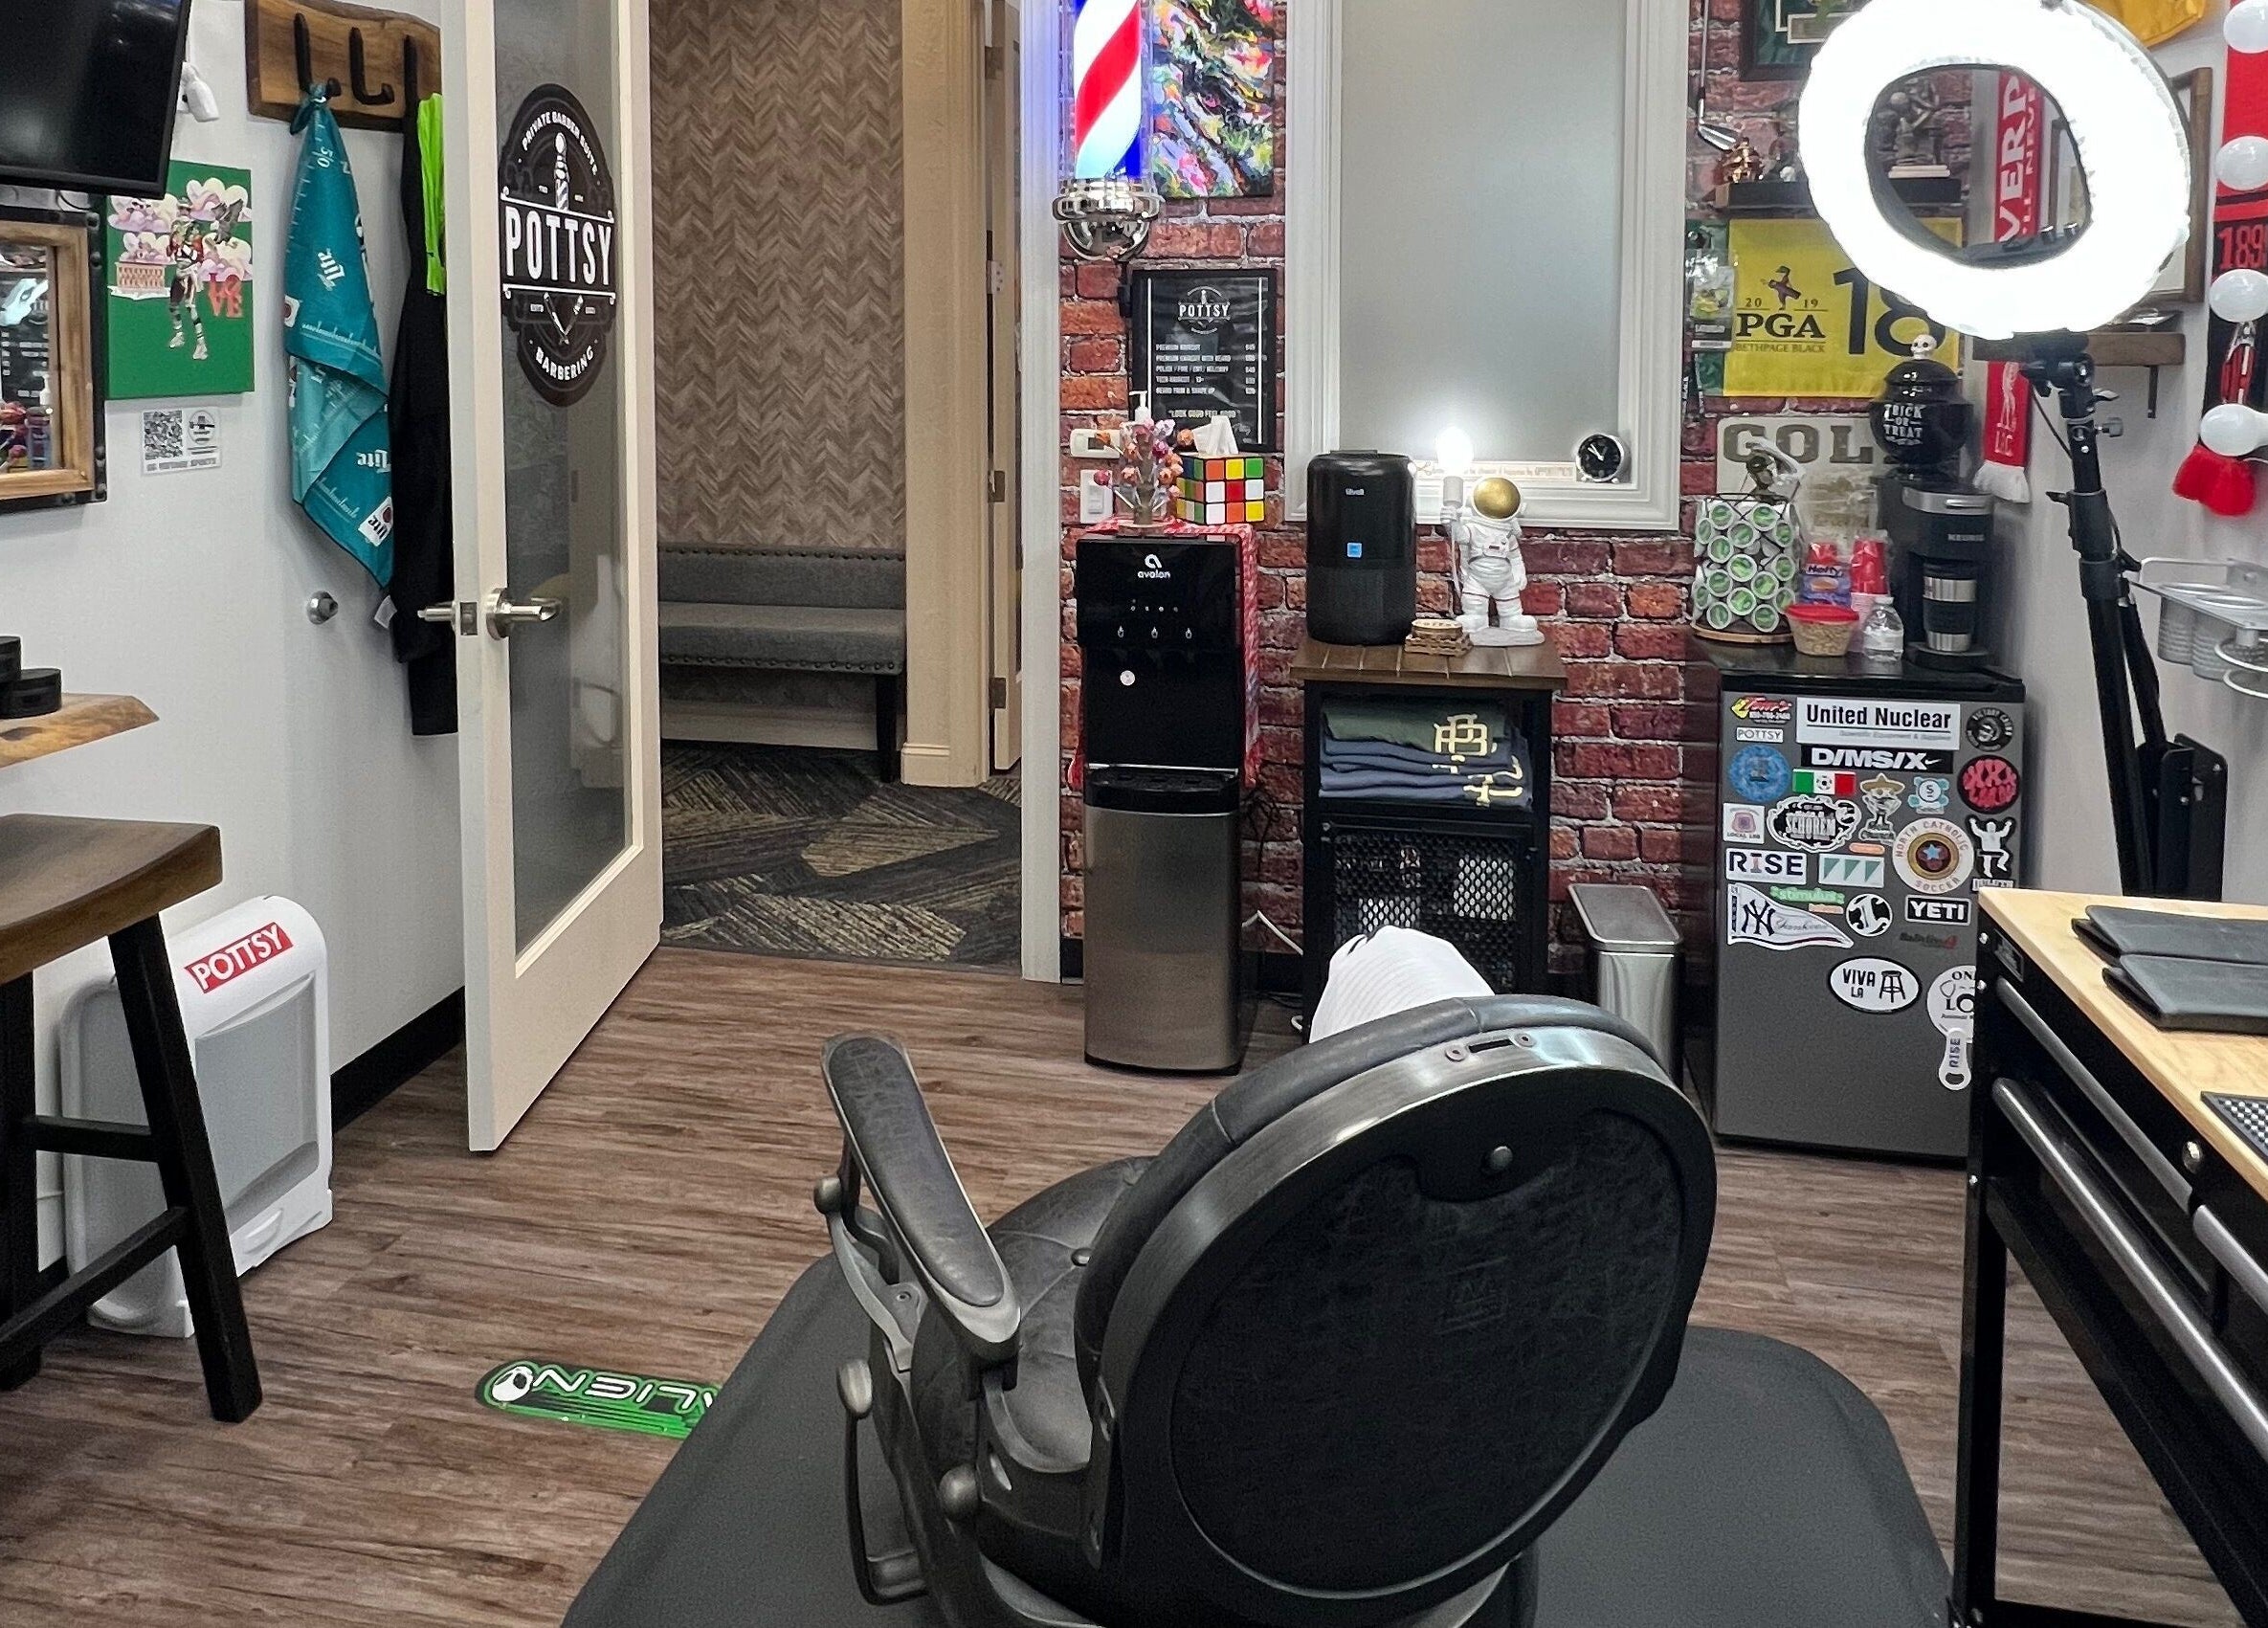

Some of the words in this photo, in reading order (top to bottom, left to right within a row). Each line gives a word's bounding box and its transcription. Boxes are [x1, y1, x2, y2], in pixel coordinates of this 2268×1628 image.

[522, 111, 551, 151] PRIVATE
[552, 111, 580, 140] BARBER
[504, 205, 612, 285] POTTSY
[2217, 223, 2268, 271] 189
[1178, 304, 1230, 318] POTTSY
[1745, 297, 1763, 308] 20
[1804, 299, 1819, 308] 19
[1833, 267, 1946, 358] 18
[1735, 312, 1827, 339] PGA
[1733, 341, 1790, 353] BETHPAGE
[1792, 342, 1826, 354] BLACK
[535, 345, 594, 381] BARBERING
[1883, 403, 1926, 421] TRICK
[1723, 423, 1901, 464] GOL
[1882, 423, 1923, 438] TREAT
[1137, 569, 1171, 579] avalon
[1806, 703, 1868, 726] United
[1875, 706, 1952, 729] Nuclear
[1737, 728, 1782, 740] POTTSY
[1896, 825, 1918, 858] NORTH
[1923, 820, 1969, 851] CATHOLIC
[1728, 851, 1804, 877] RISE
[1915, 877, 1961, 893] SOCCER
[1741, 899, 1777, 937] NY
[1909, 900, 1966, 921] YETI
[191, 924, 283, 991] POTTSY
[1842, 968, 1877, 988] VIVA
[1850, 986, 1864, 998] LA
[1948, 1037, 1961, 1069] RISE
[532, 1368, 714, 1411] LIEN
